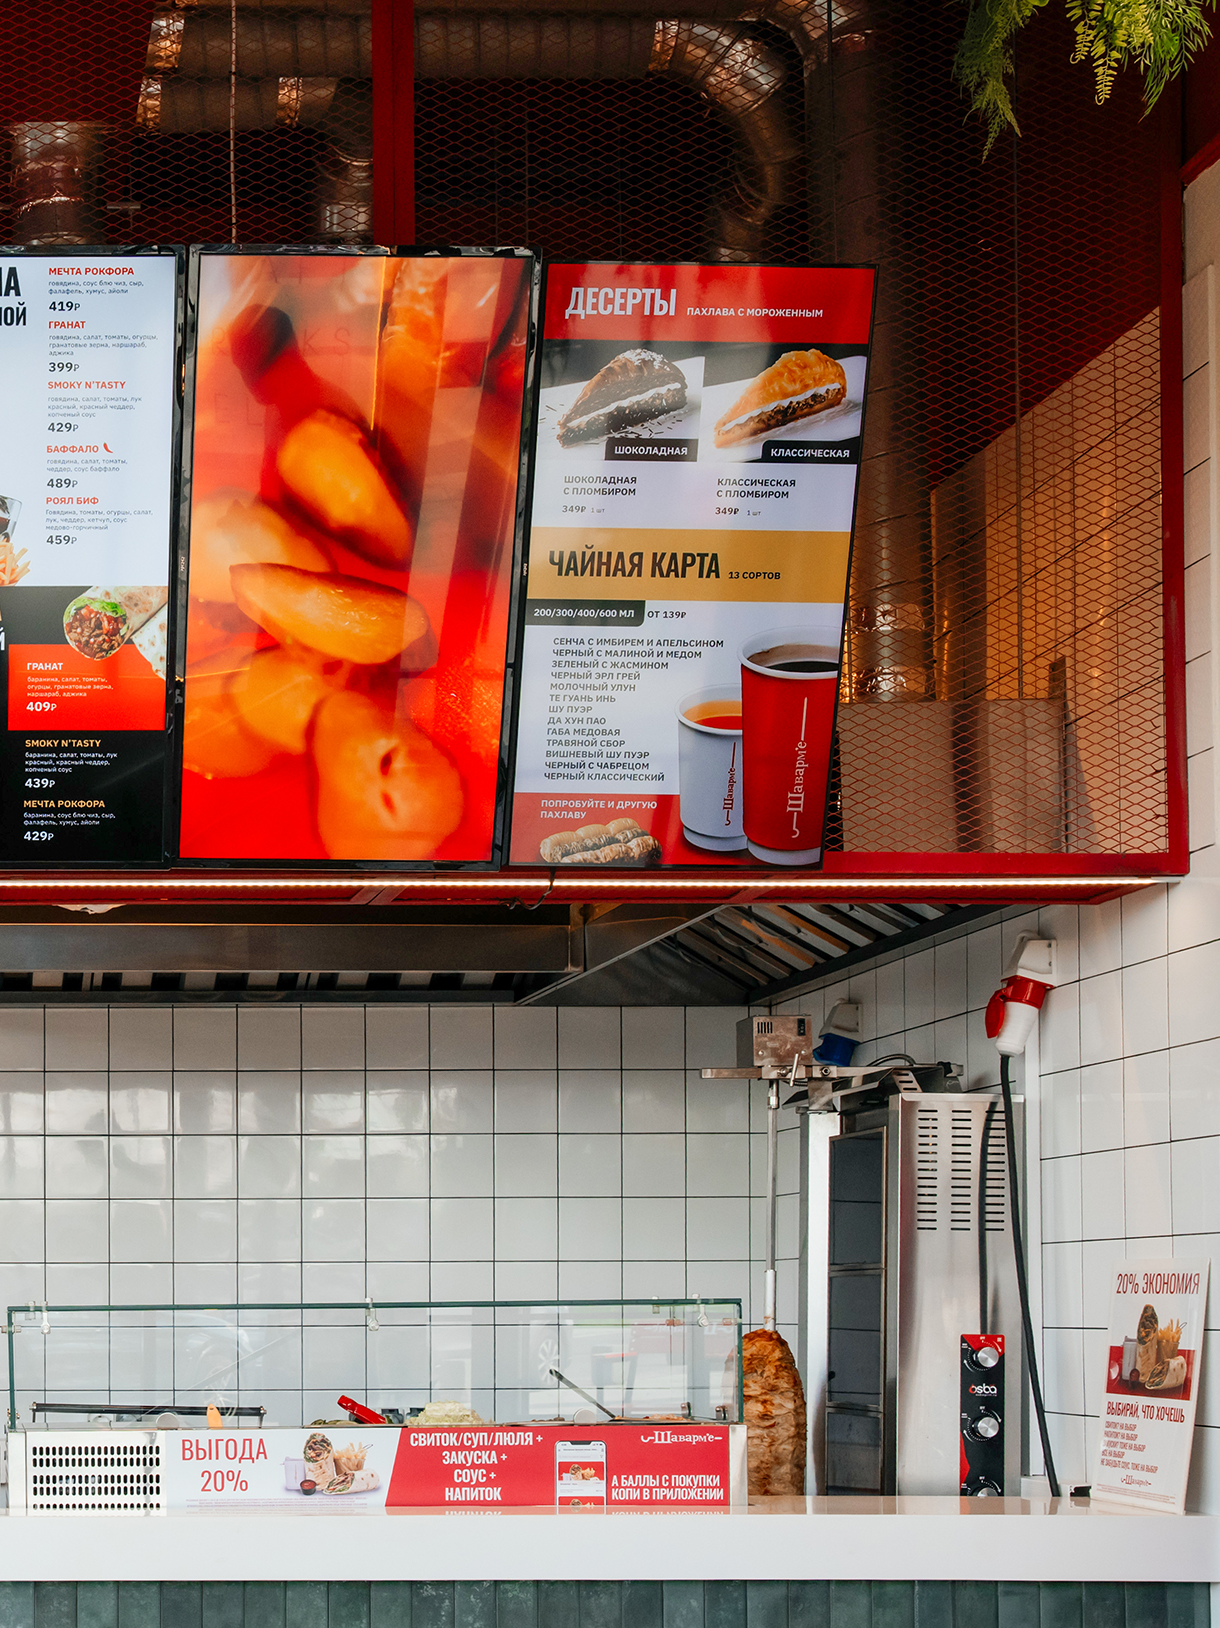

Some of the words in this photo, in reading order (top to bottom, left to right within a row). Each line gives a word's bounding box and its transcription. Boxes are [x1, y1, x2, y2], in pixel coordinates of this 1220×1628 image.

[565, 287, 677, 319] ДЕСЕРТЫ
[687, 308, 736, 316] ПАХЛАВА
[746, 308, 823, 317] МОРОЖЕННЫМ
[47, 445, 98, 453] БАФФАЛО
[615, 446, 688, 456] ШОКОЛАДНАЯ
[771, 449, 849, 457] КЛАССИЧЕСКАЯ
[565, 476, 636, 485] ШОКОЛАДНАЯ
[549, 545, 643, 577] ЧАЙНАЯ
[651, 552, 720, 579] КАРТА
[729, 571, 739, 579] 13
[742, 572, 780, 580] СОРТОВ
[534, 609, 617, 618] 200/300/400/600
[550, 682, 608, 691] МОЛОЧНЫЙ
[544, 771, 584, 780] ЧЕРНЫЙ
[588, 772, 664, 781] КЛАССИЧЕСКИЙ
[542, 799, 605, 808] ПОПРОБУЙТЕ
[616, 800, 658, 810] ДРУГУЮ
[1116, 1273, 1139, 1294] 20%
[1142, 1273, 1200, 1295] ЭКОНОМИЯ
[1106, 1401, 1140, 1420] ВЫБИРАЙ,
[1142, 1405, 1156, 1419] ЧТО
[1155, 1406, 1185, 1423] ХОЧЕШЬ
[410, 1432, 533, 1448] СВИТОК/СУП/ЛЮЛЯ
[182, 1438, 267, 1463] ВЫГОДА
[442, 1451, 498, 1466] ЗАКУСКА
[201, 1470, 248, 1492] 20%
[454, 1469, 486, 1485] СОУС
[621, 1475, 660, 1487] БАЛЛЫ
[672, 1475, 720, 1487] ПОКУПКИ
[445, 1487, 501, 1501] НАПИТОК
[612, 1488, 640, 1500] КОПИ
[656, 1488, 723, 1500] ПРИЛОЖЕНИИ
